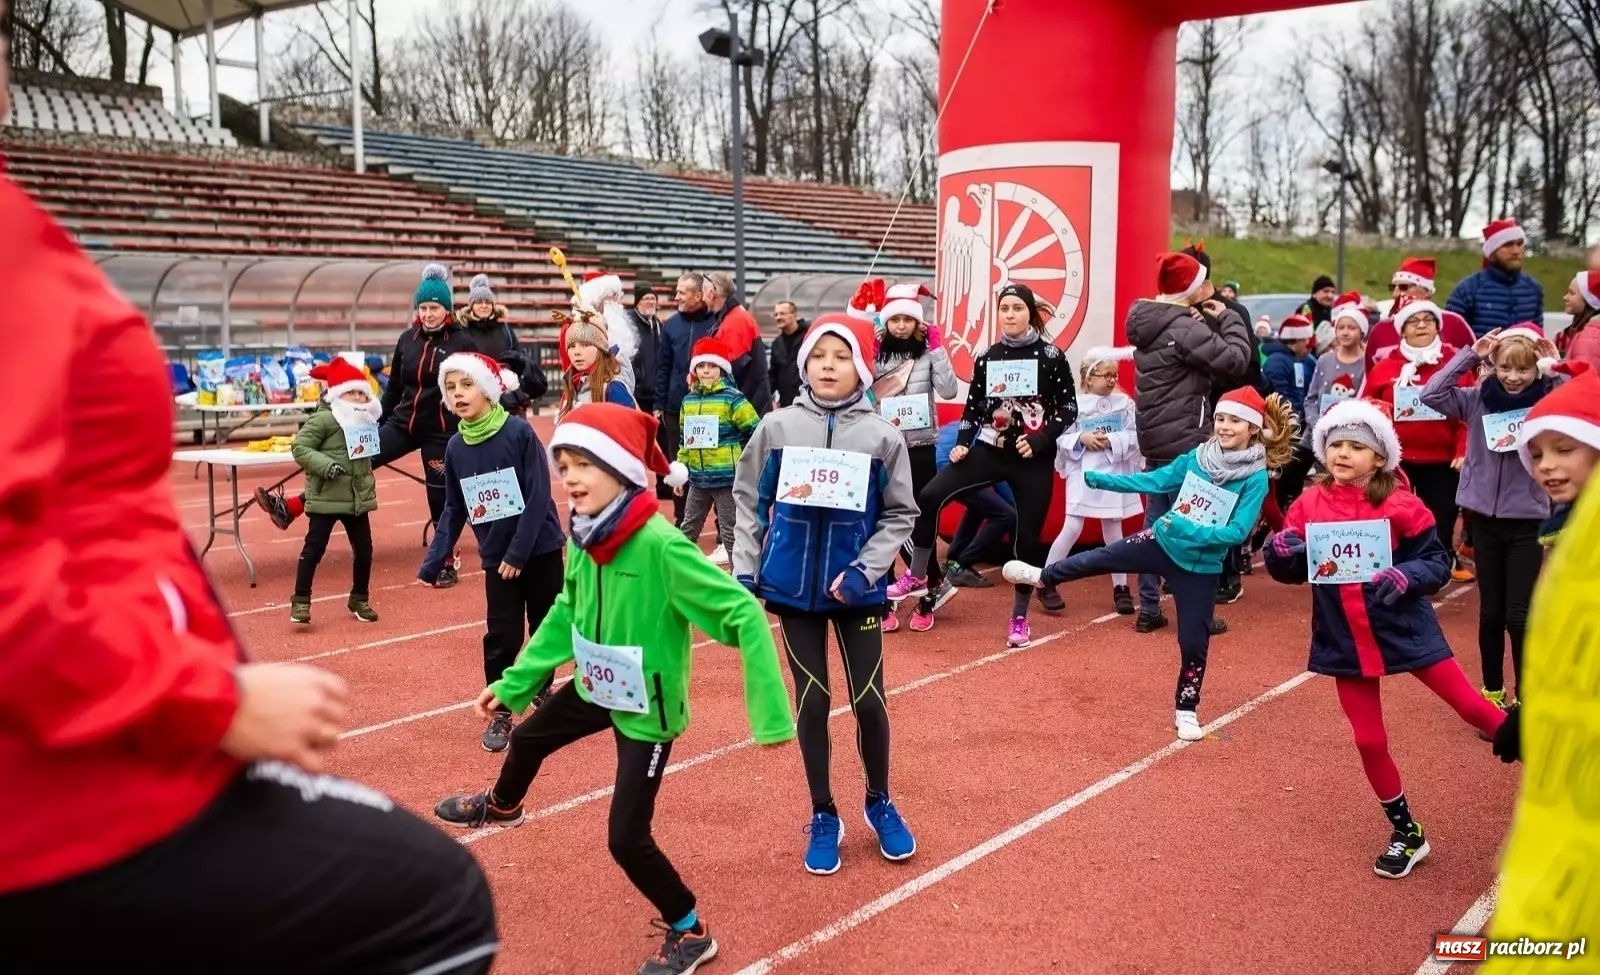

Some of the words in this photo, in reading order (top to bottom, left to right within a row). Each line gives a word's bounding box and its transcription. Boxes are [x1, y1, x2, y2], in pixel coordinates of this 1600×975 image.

[1004, 372, 1020, 382] 167
[897, 407, 912, 417] 183
[359, 433, 372, 443] 050
[692, 426, 705, 435] 097
[810, 468, 839, 484] 159
[478, 488, 500, 503] 036
[1190, 494, 1212, 511] 207
[1331, 543, 1361, 559] 041
[586, 661, 614, 683] 030
